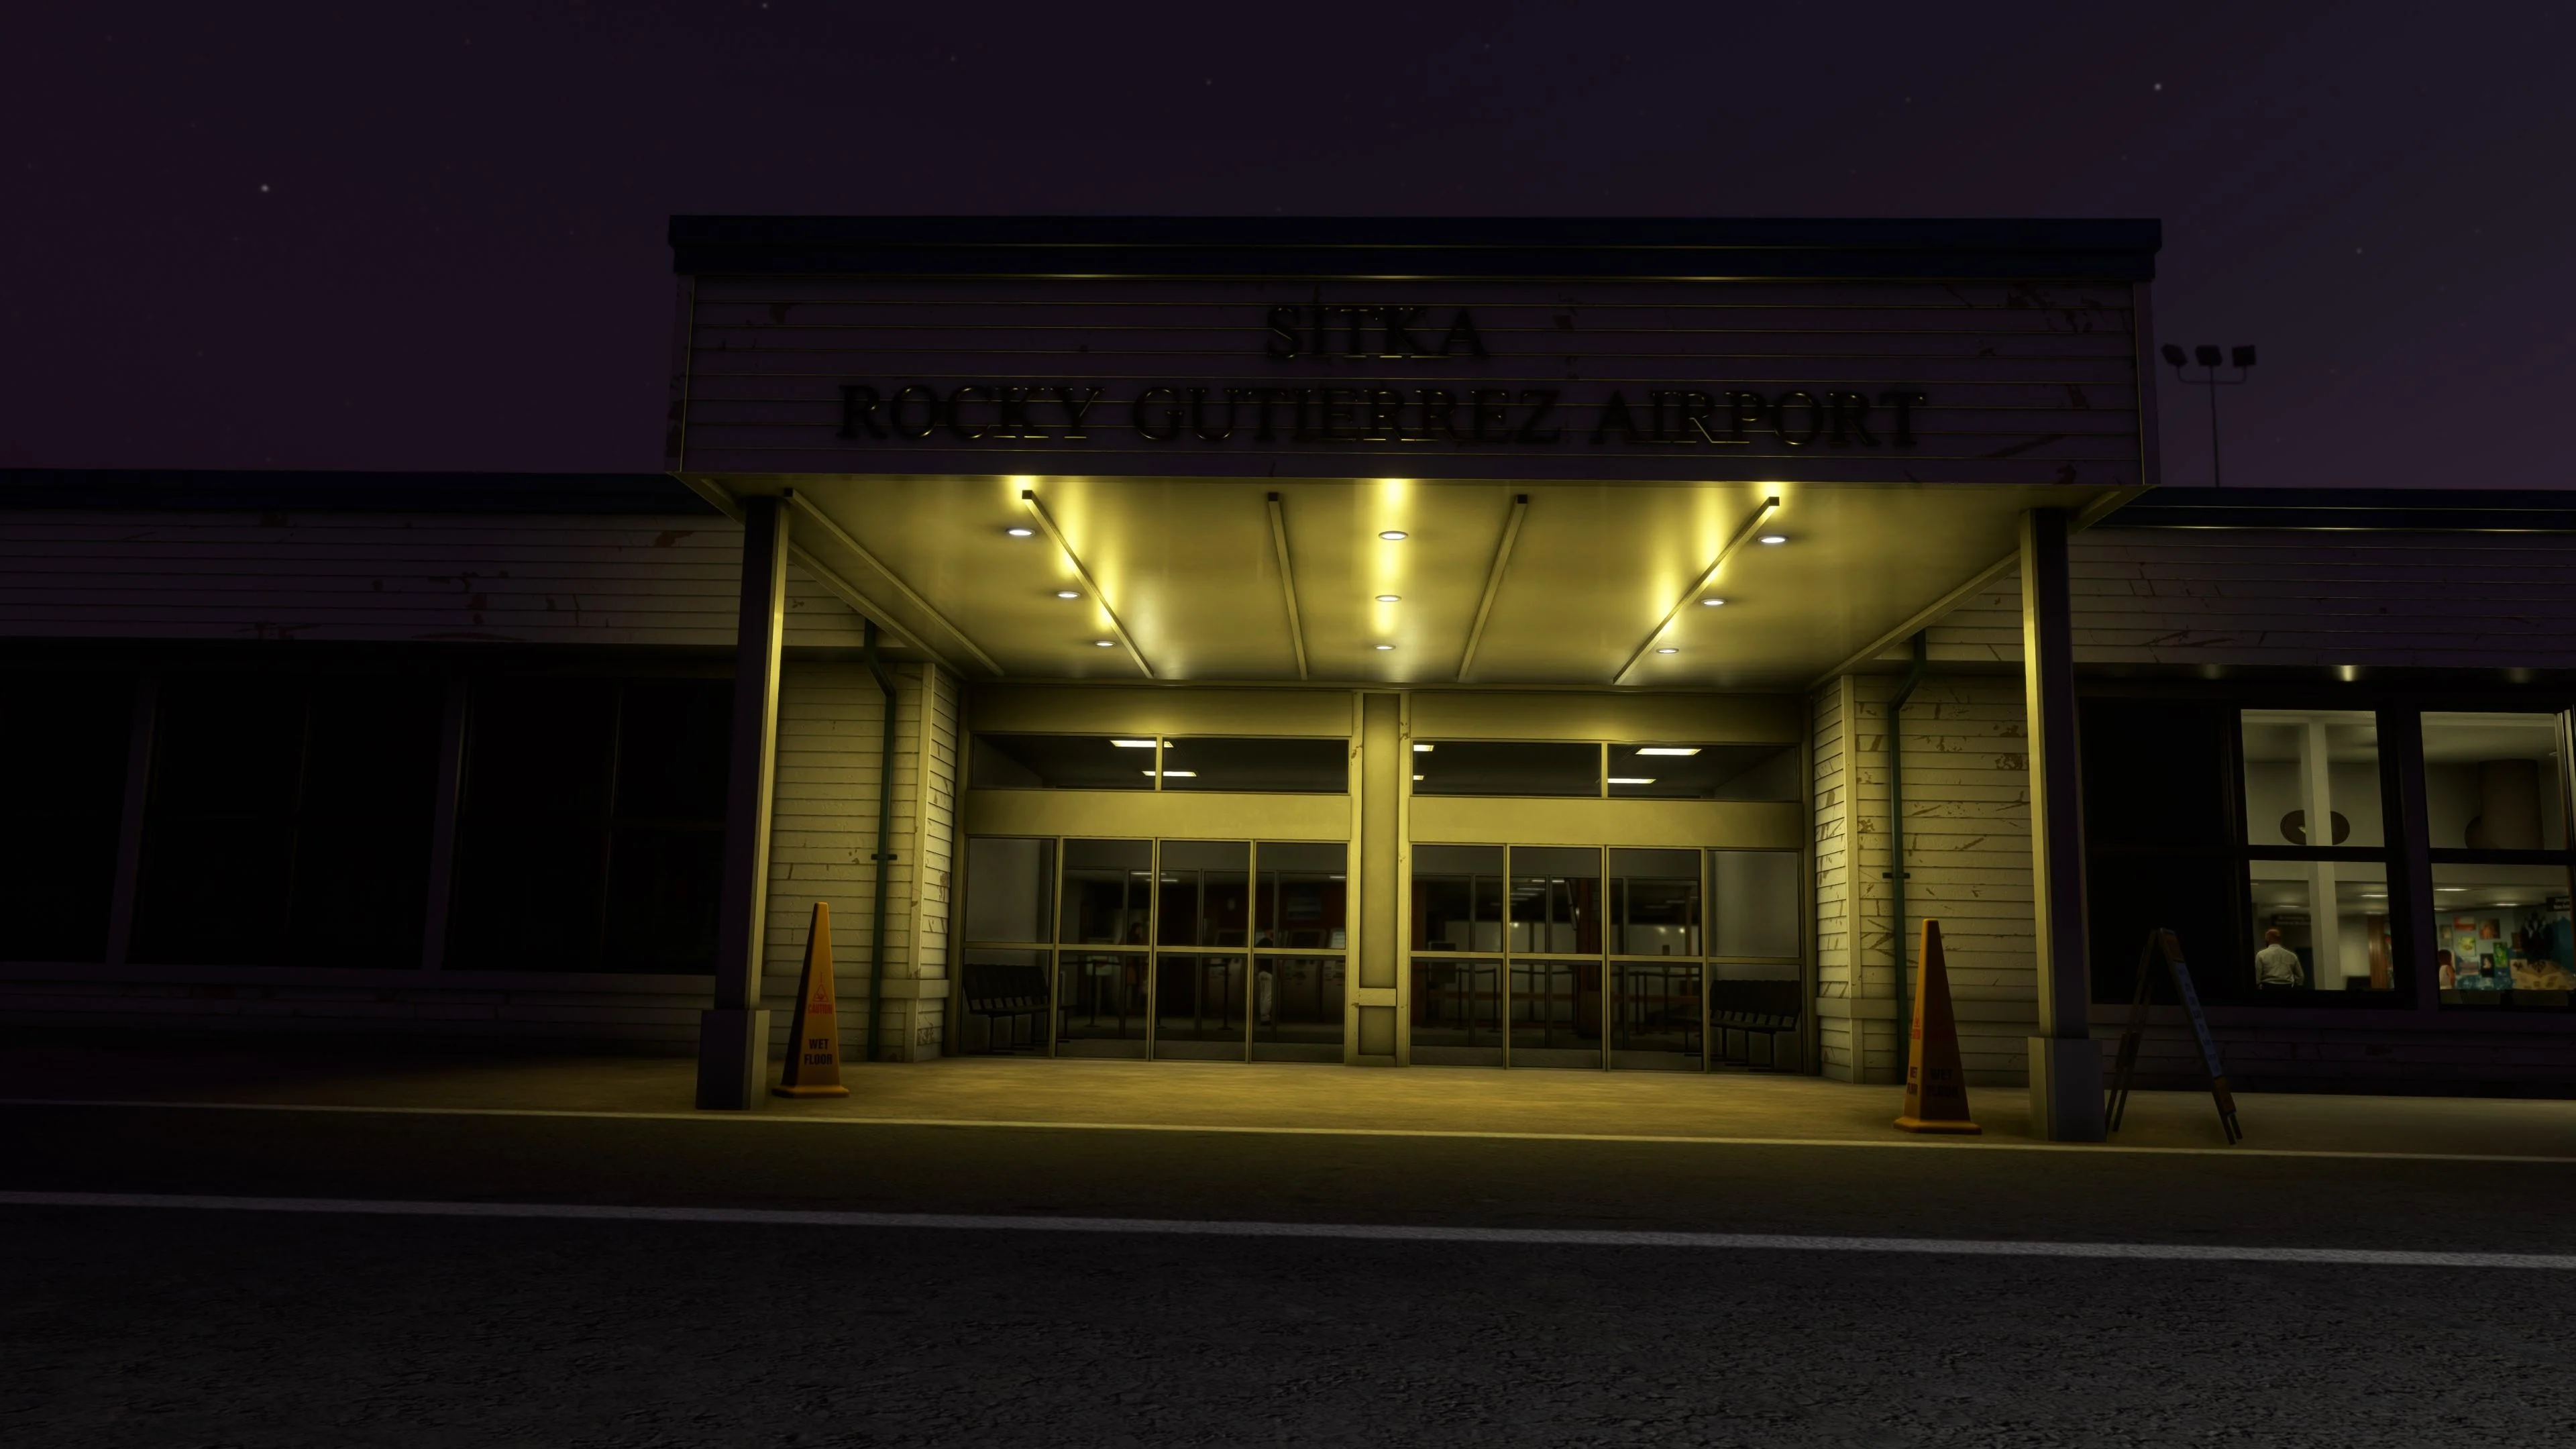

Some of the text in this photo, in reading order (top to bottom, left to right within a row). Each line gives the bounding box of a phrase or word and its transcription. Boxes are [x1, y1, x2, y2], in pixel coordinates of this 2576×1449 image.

[1267, 304, 1491, 360] SITKA
[836, 384, 1928, 446] ROCKY GUTIERREZ AIRPORT
[804, 1053, 833, 1065] FLOOR
[808, 1038, 829, 1050] WET
